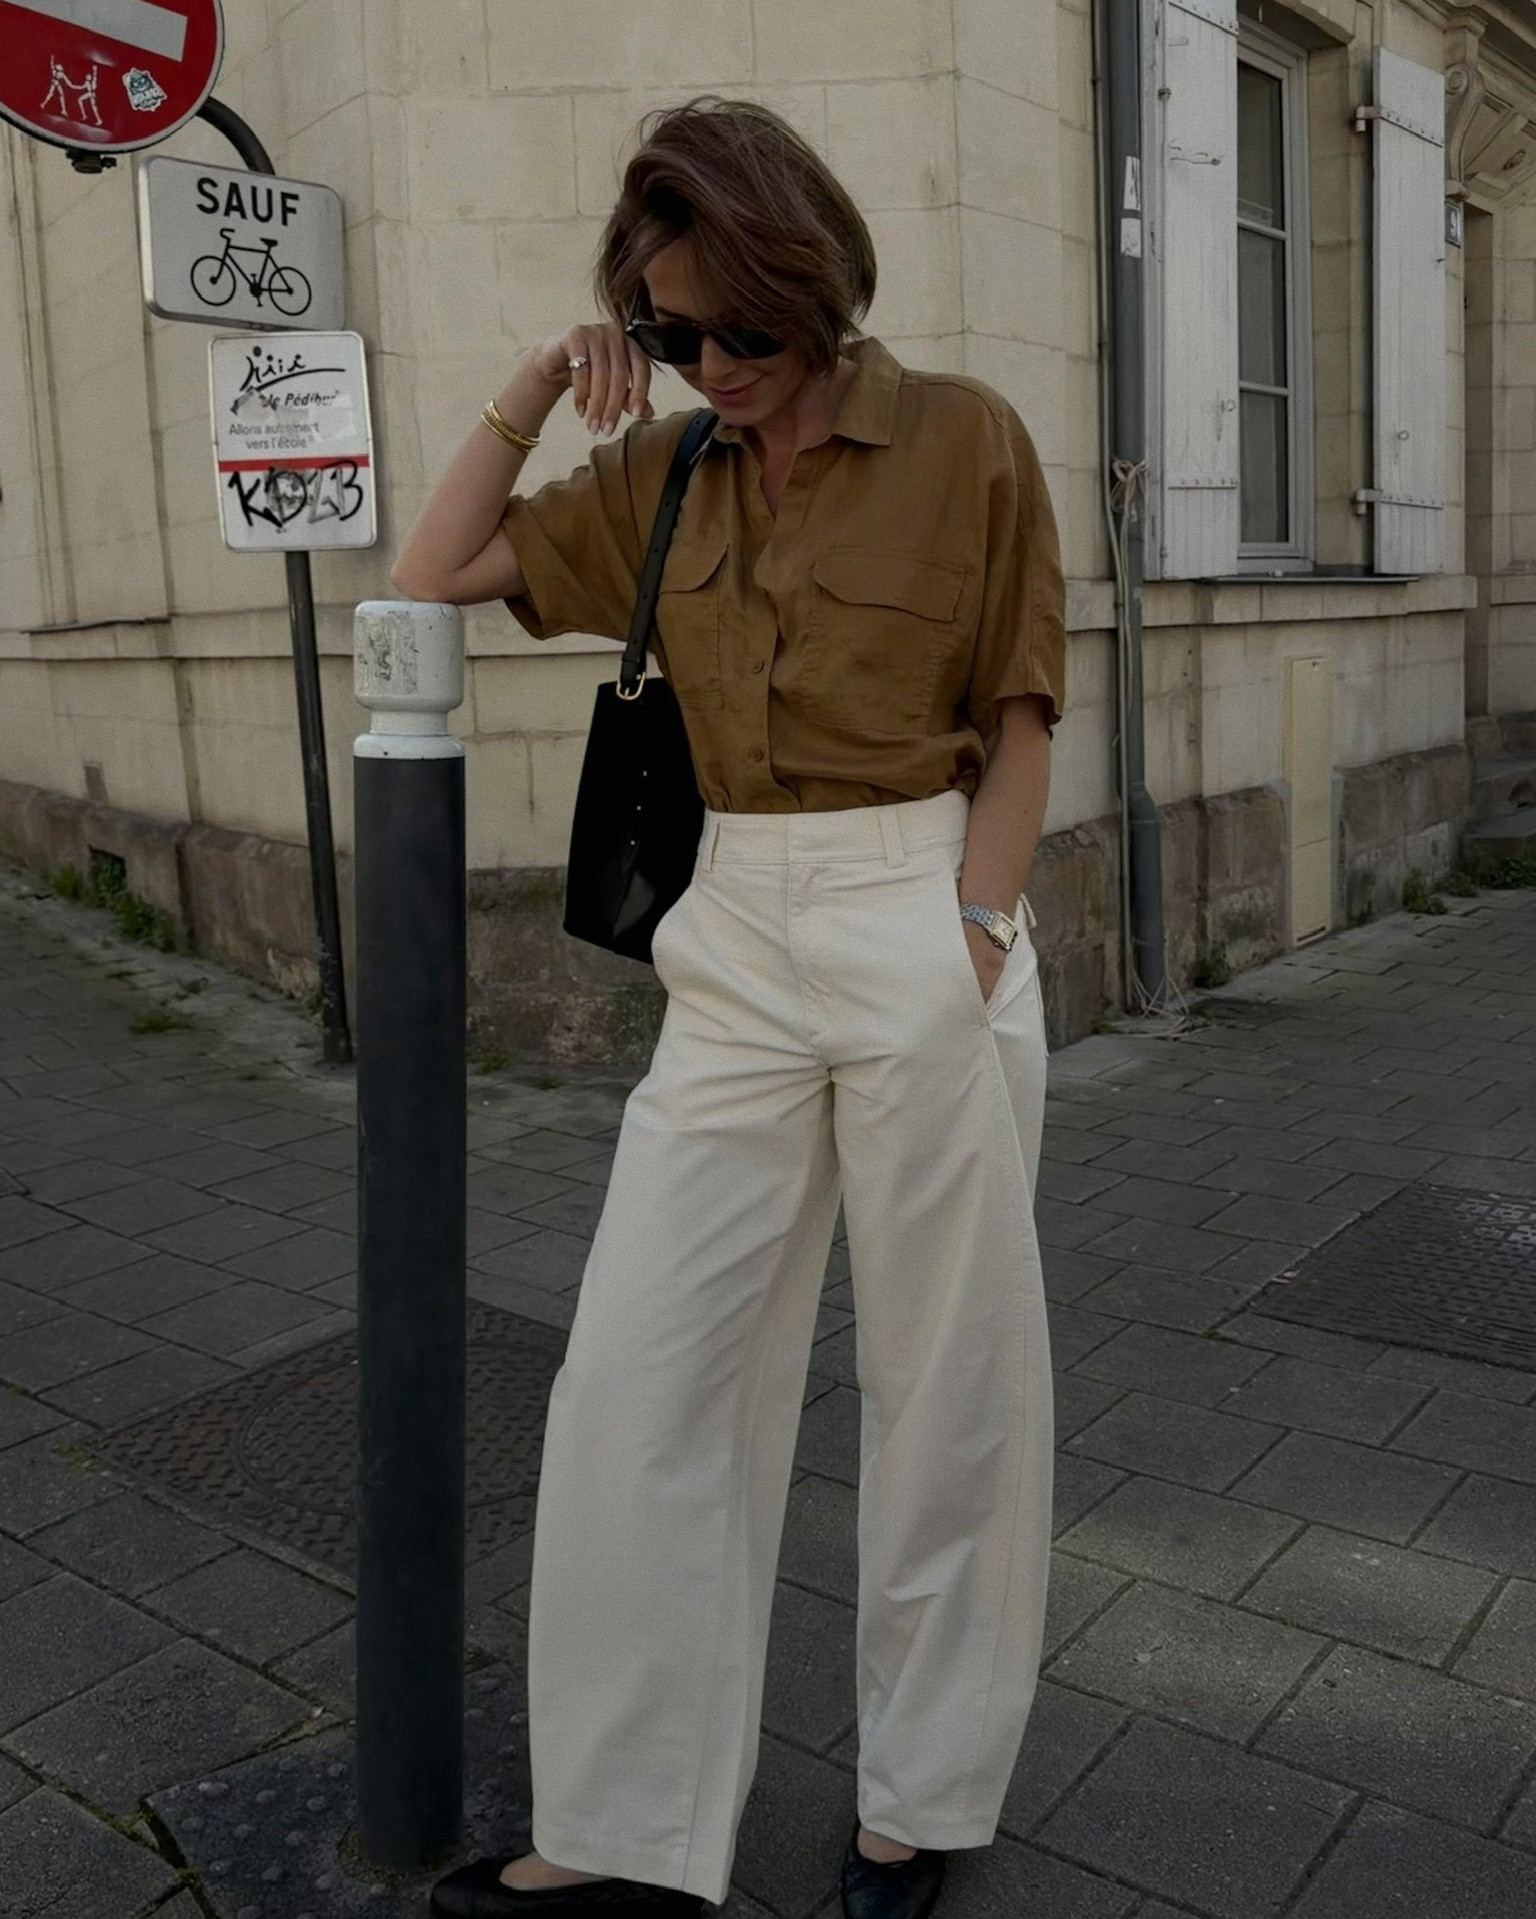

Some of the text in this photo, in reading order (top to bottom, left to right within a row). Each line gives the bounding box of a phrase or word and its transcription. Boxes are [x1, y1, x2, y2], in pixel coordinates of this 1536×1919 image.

[196, 177, 299, 226] SAUF
[229, 423, 262, 435] Allons
[246, 439, 269, 449] vers
